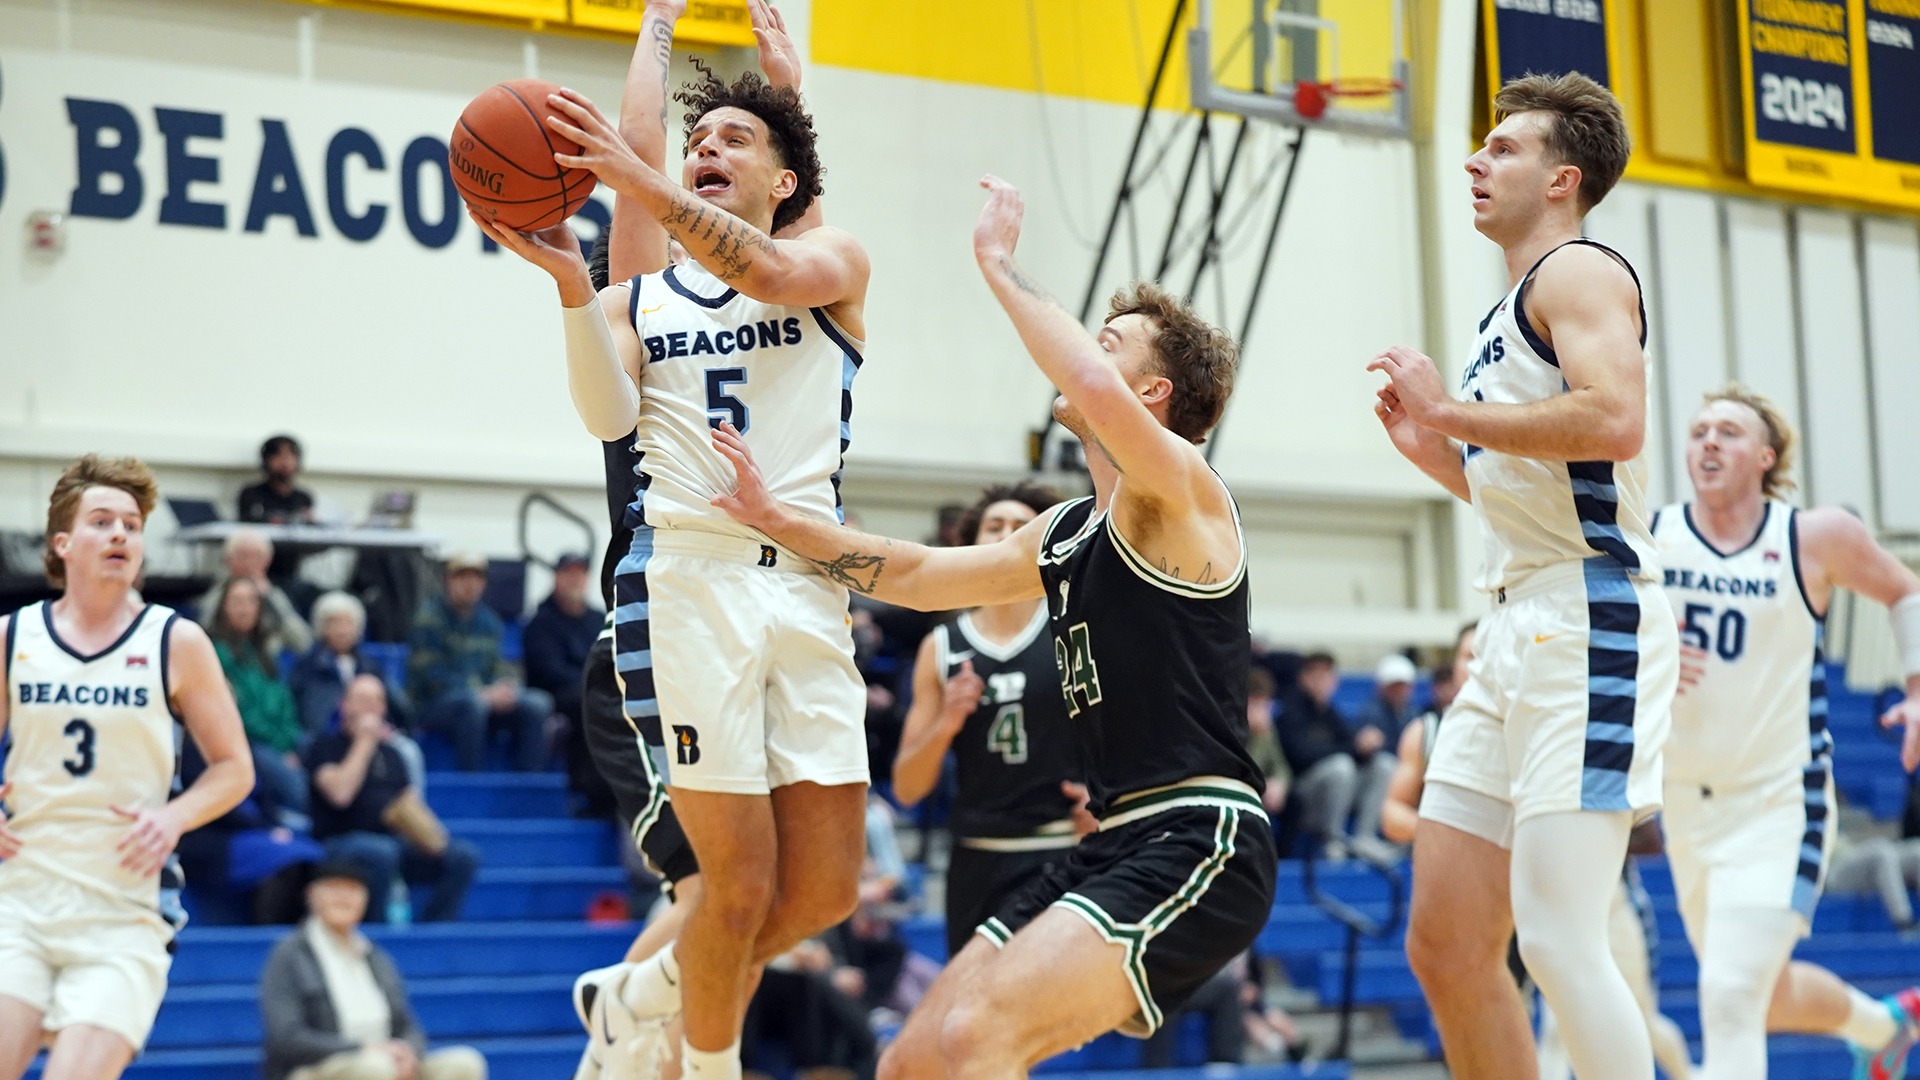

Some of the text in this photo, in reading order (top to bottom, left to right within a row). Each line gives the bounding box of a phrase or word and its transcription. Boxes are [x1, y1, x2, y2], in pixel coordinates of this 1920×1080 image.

[1761, 72, 1846, 131] 2024
[64, 96, 612, 261] BEACO
[643, 316, 803, 363] BEACONS
[704, 366, 750, 437] 5
[1663, 569, 1777, 597] BEACONS
[1681, 602, 1746, 663] 50
[19, 683, 149, 708] BEACONS
[1055, 621, 1102, 719] 24
[63, 718, 96, 778] 3
[672, 724, 701, 765] B
[987, 702, 1029, 765] 4
